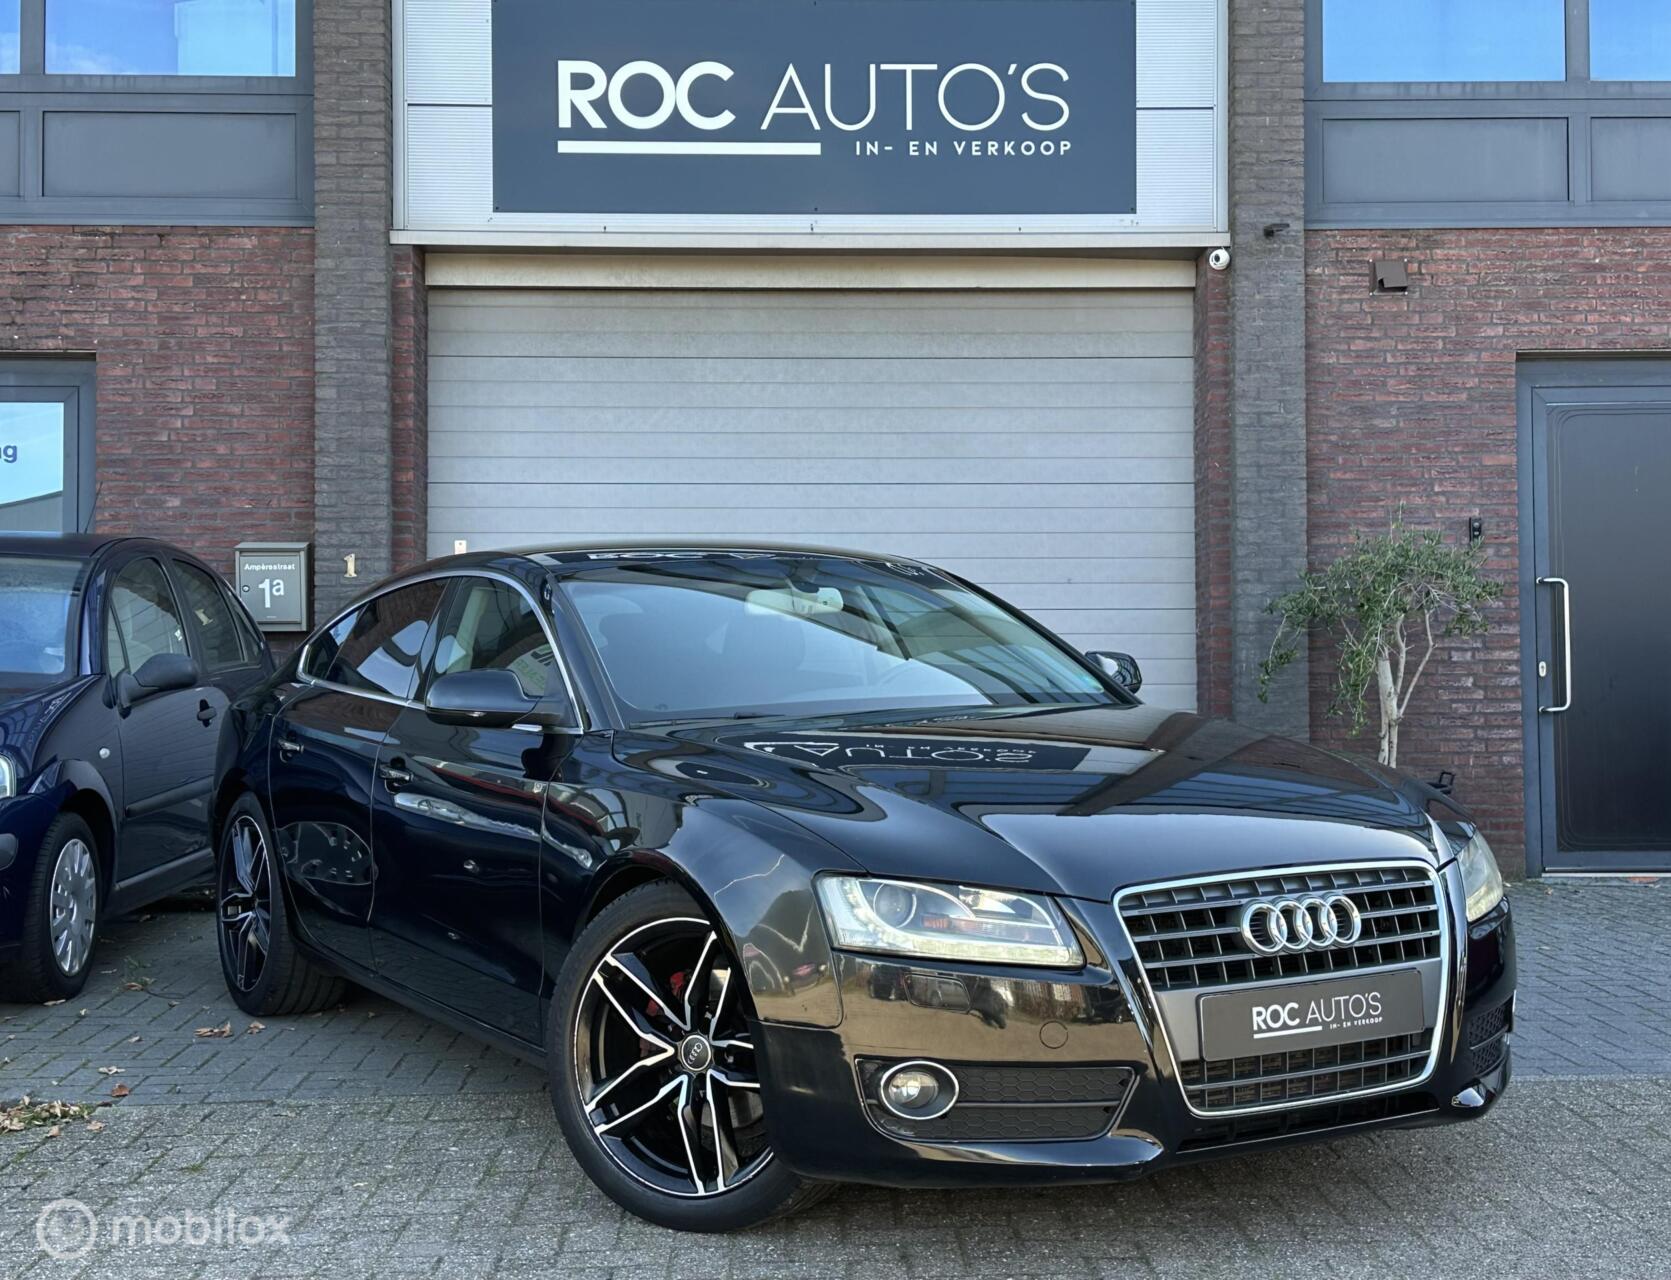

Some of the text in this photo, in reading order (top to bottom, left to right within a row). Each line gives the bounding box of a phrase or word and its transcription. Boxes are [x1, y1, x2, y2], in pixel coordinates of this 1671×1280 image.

[557, 60, 1070, 132] ROC AUTO'S
[855, 140, 1072, 156] IN- EN VERKOOP
[0, 444, 18, 464] g
[343, 553, 358, 578] 1
[258, 578, 285, 609] 1a
[1252, 992, 1382, 1031] ROC AUTO'S
